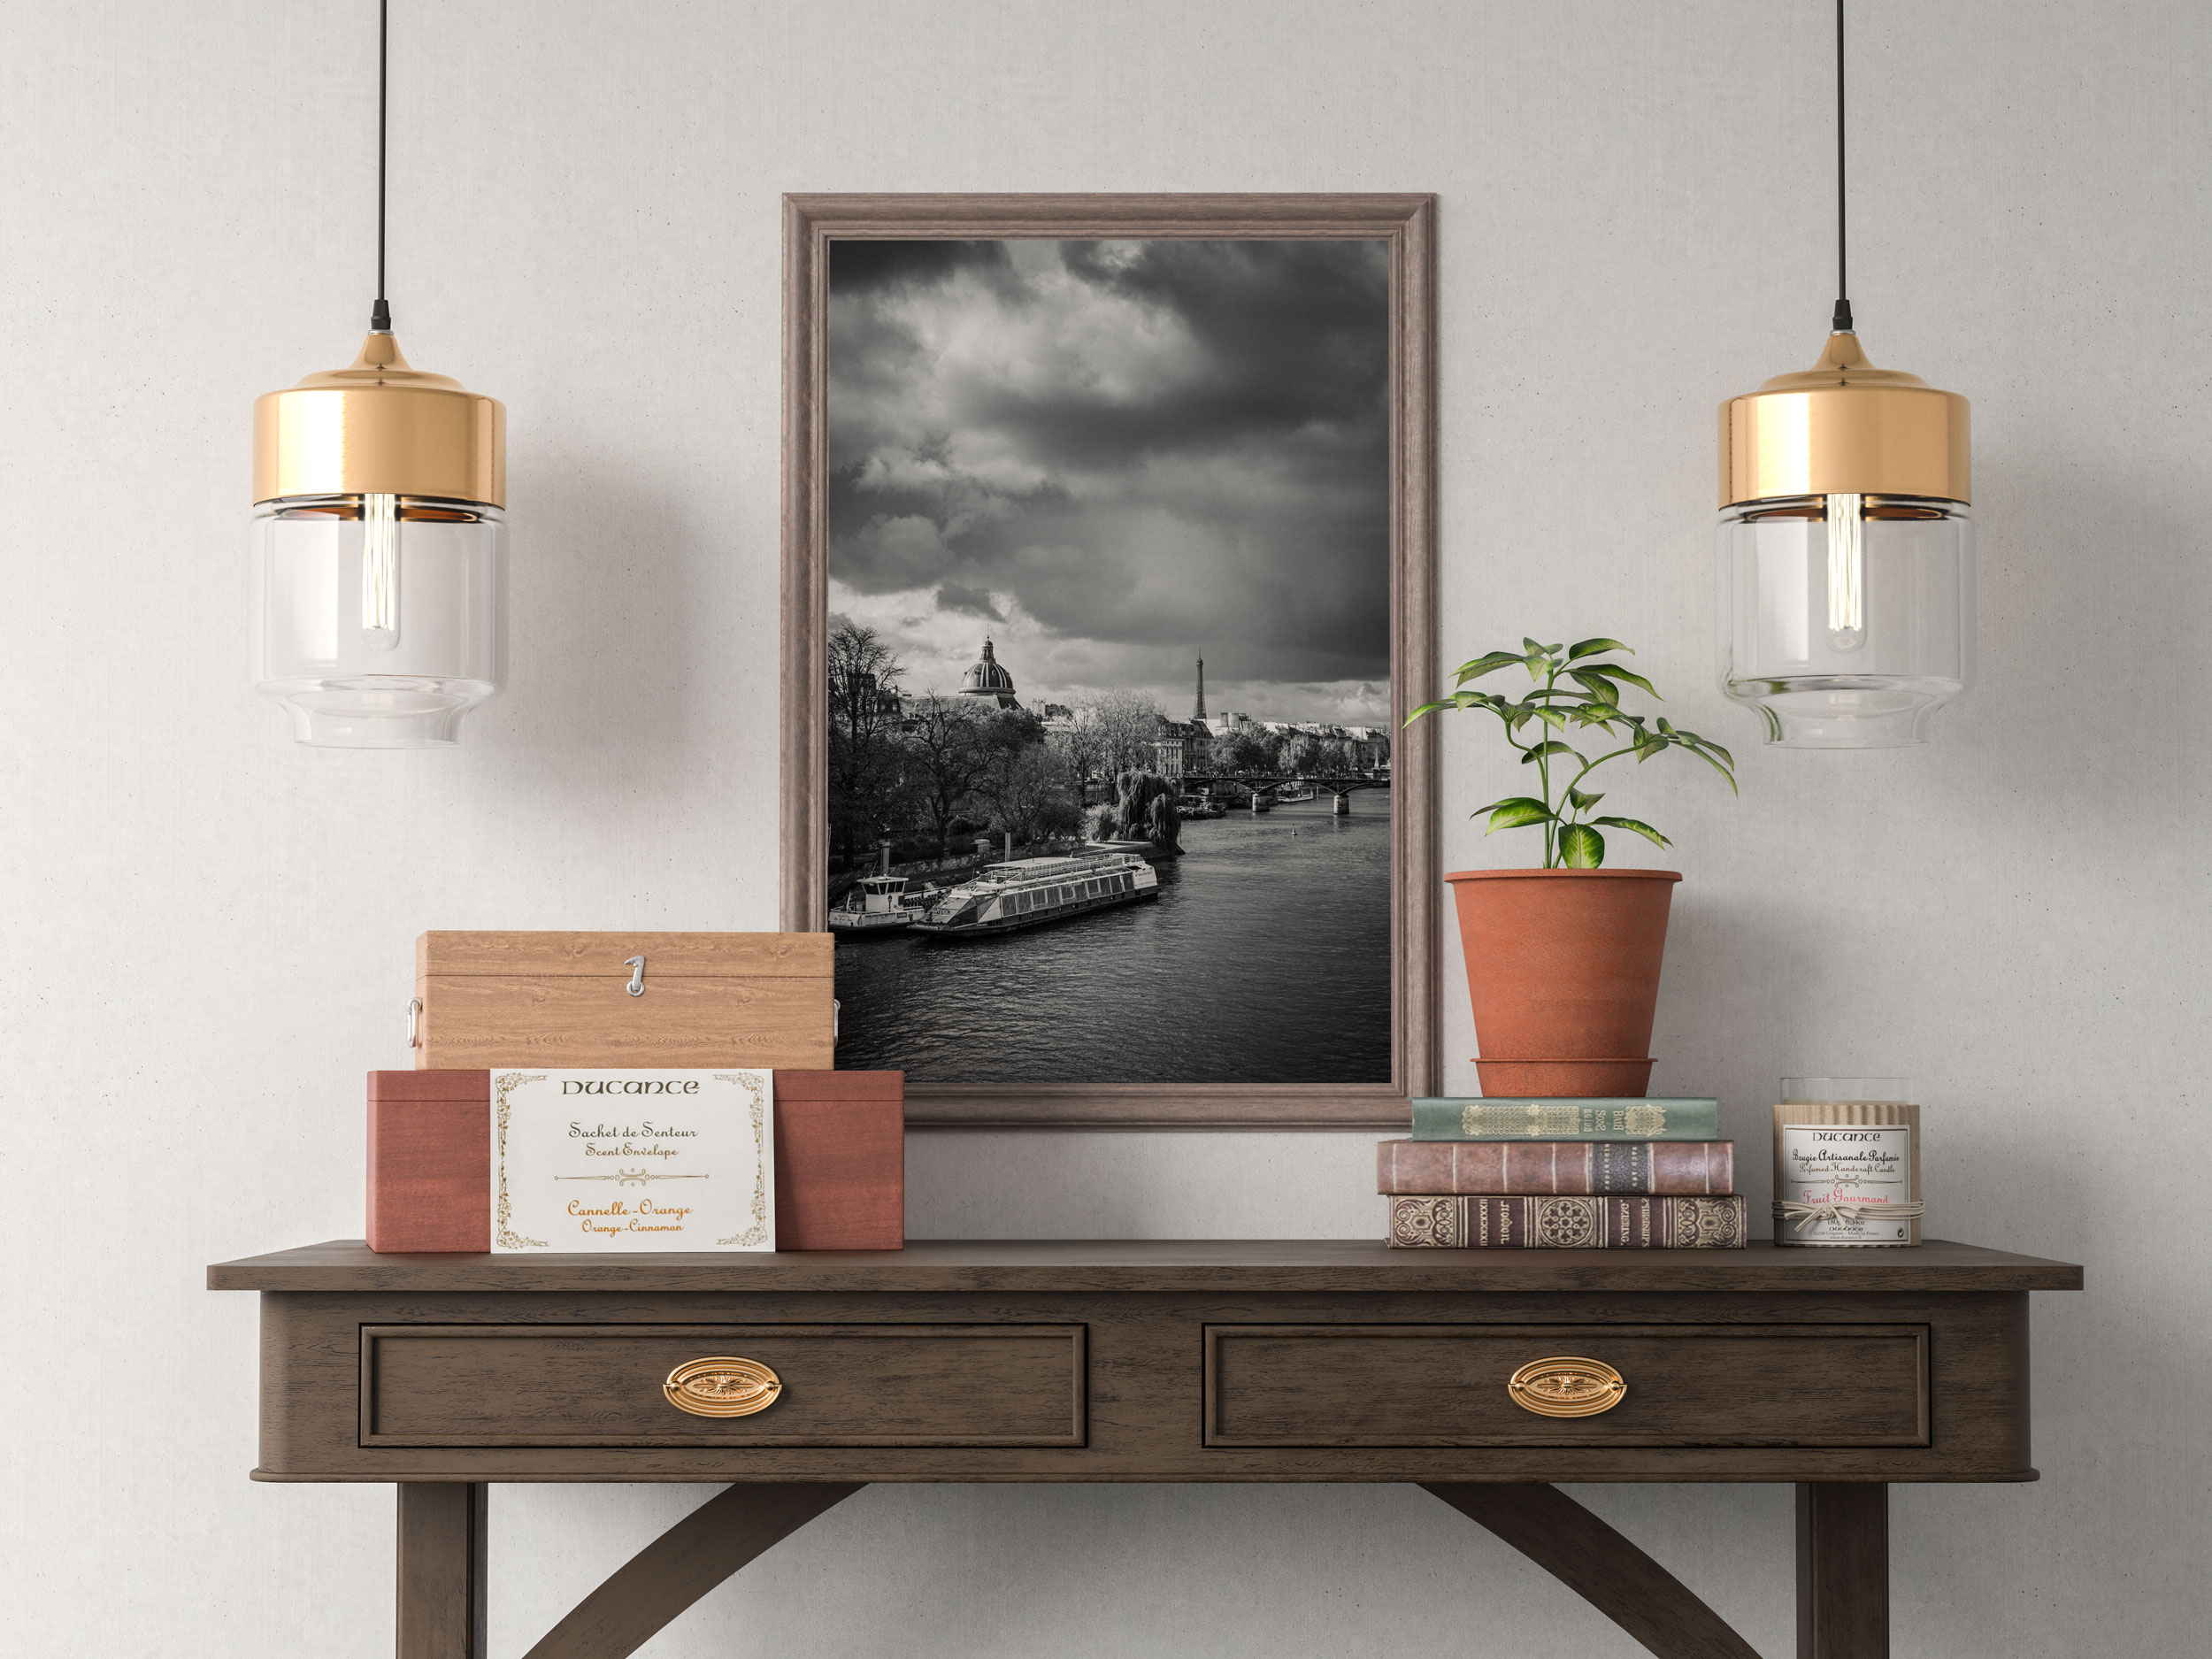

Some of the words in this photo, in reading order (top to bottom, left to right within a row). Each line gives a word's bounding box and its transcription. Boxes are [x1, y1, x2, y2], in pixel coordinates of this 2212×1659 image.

[568, 1121, 619, 1138] Sachet
[622, 1126, 640, 1138] de
[641, 1121, 698, 1138] Senteur
[585, 1142, 621, 1156] Scent
[622, 1141, 679, 1160] Envelope
[1792, 1148, 1817, 1165] Bougie
[1818, 1149, 1868, 1161] Artisanale
[1802, 1190, 1832, 1204] Fruit
[1833, 1187, 1889, 1204] Gourmand
